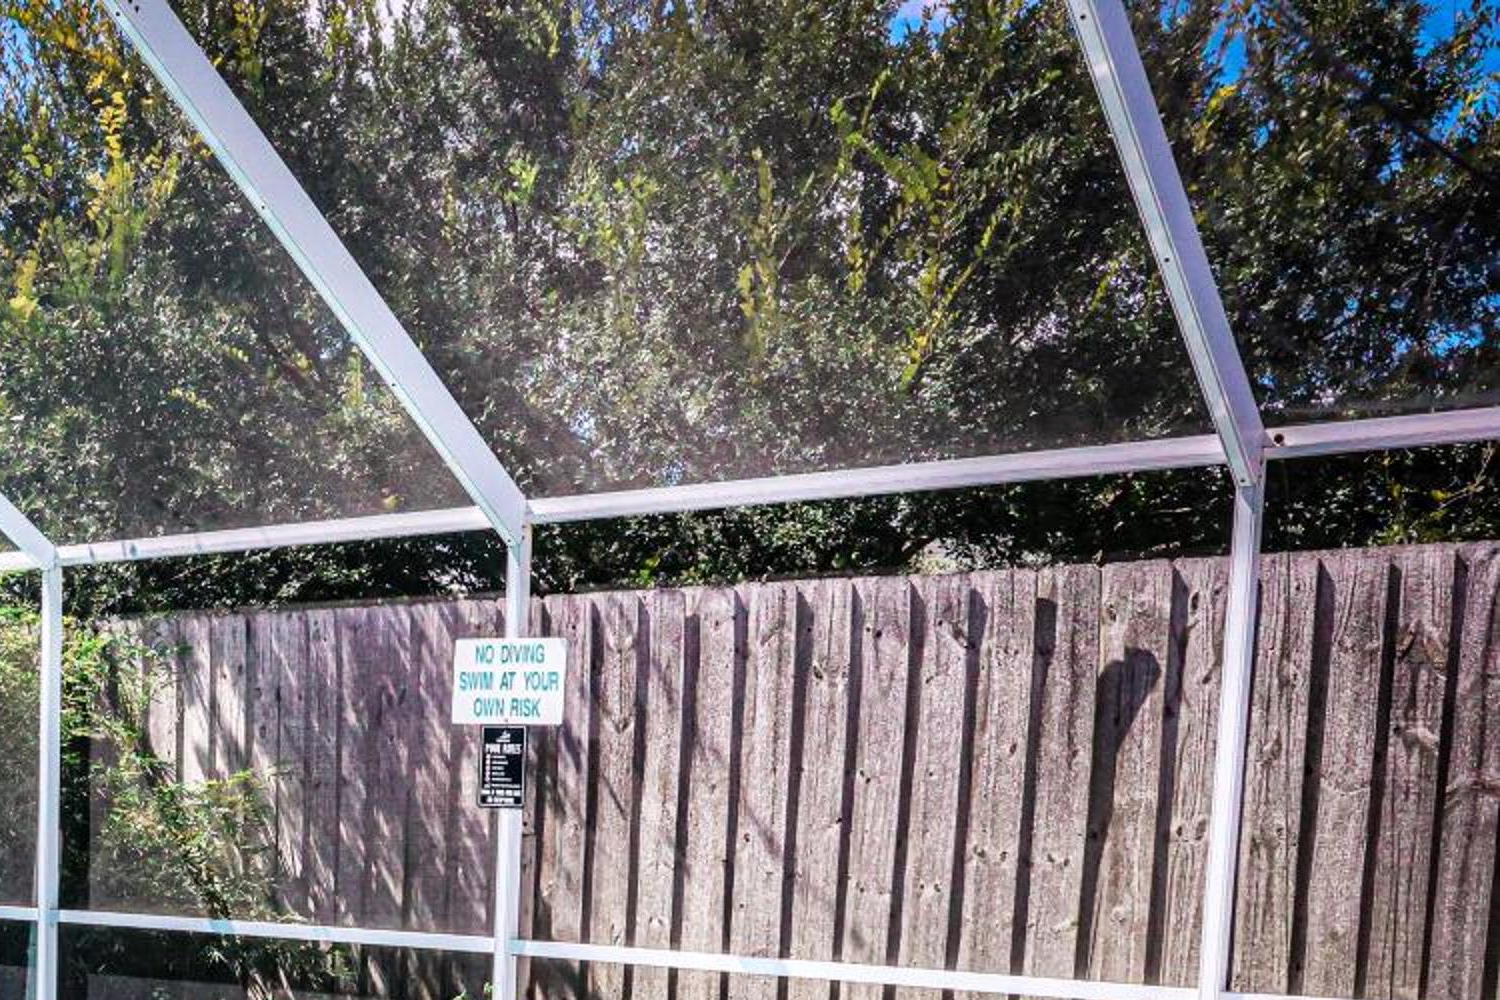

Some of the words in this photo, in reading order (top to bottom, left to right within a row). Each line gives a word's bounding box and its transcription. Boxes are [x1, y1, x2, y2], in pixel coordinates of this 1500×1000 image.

[475, 644, 494, 664] NO
[501, 644, 545, 664] DIVING
[459, 671, 493, 691] SWIM
[500, 671, 517, 691] AT
[524, 671, 559, 691] YOUR
[473, 698, 505, 717] OWN
[510, 698, 541, 718] RISK
